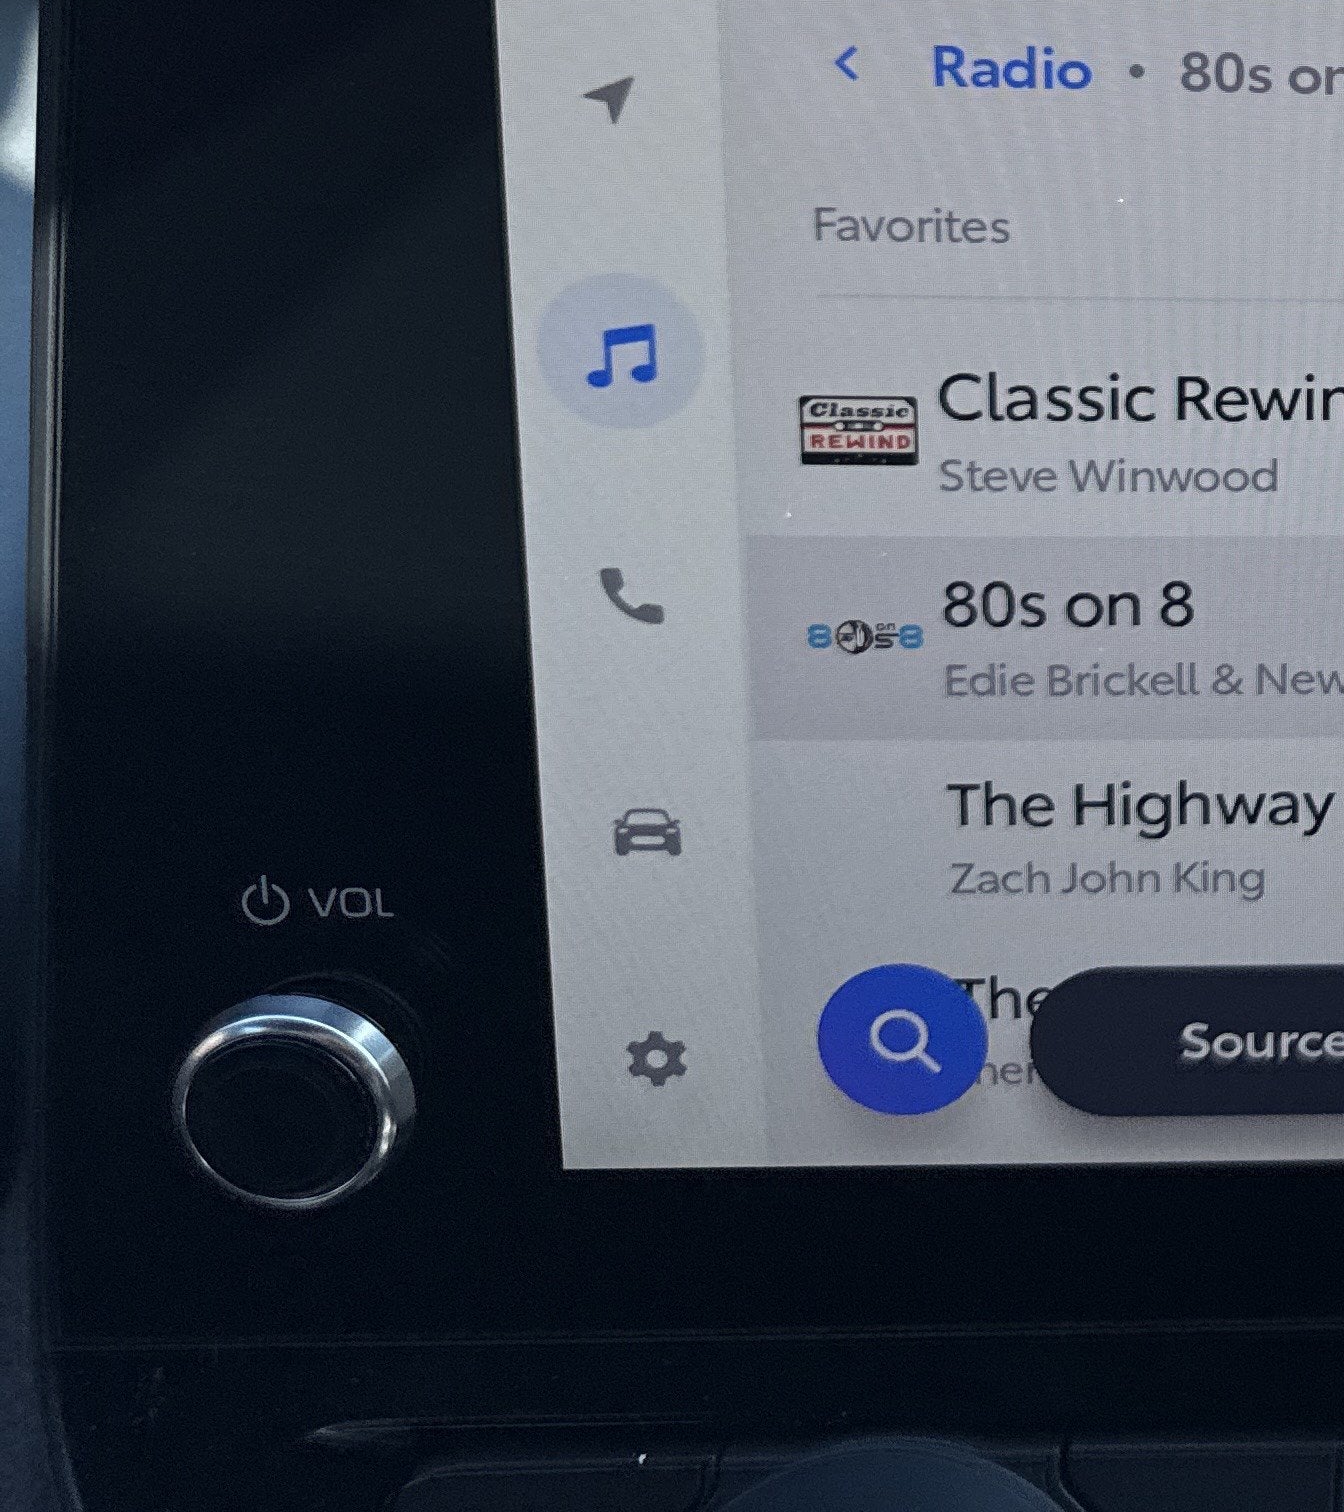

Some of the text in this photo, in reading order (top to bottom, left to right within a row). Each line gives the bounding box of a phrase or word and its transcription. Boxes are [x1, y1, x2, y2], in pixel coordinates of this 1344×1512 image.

[933, 45, 1093, 91] Radio
[1181, 51, 1273, 95] 80s
[813, 207, 1011, 245] Favorites
[810, 401, 910, 418] Classic
[938, 372, 1157, 423] Classic
[810, 433, 912, 450] REWIND
[939, 458, 1279, 494] Steve Winwood
[942, 580, 1194, 630] 80s on 8
[944, 664, 1036, 699] Edie
[1047, 663, 1200, 699] Brickell
[1212, 664, 1243, 698] &
[946, 781, 1336, 841] The Highway
[951, 861, 1266, 902] Zach John King
[308, 887, 395, 918] VOL
